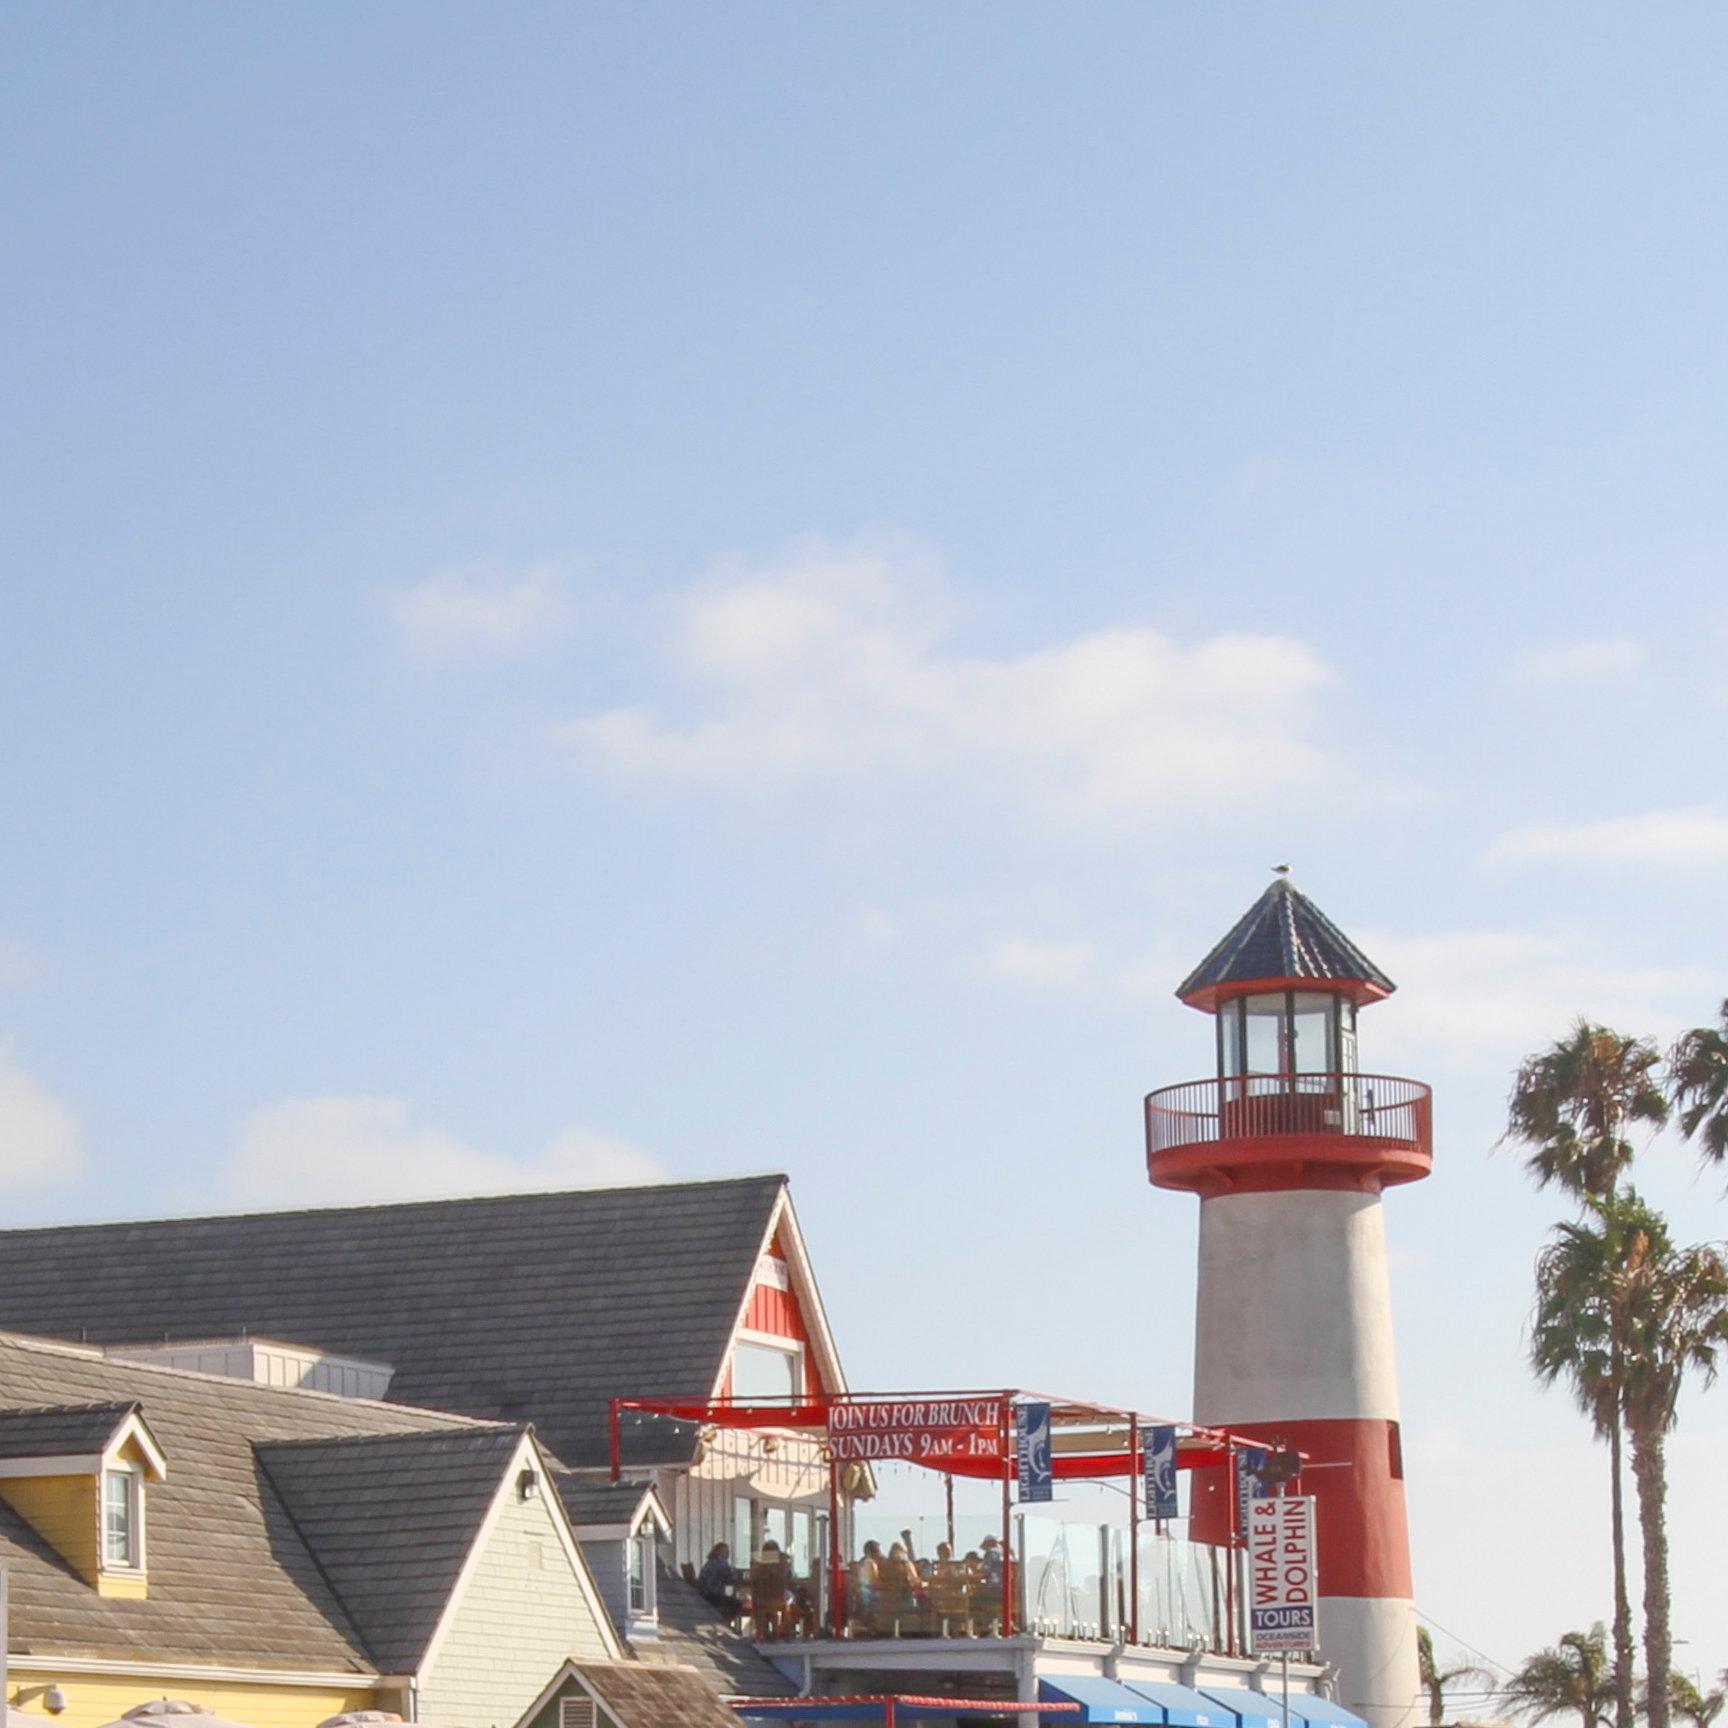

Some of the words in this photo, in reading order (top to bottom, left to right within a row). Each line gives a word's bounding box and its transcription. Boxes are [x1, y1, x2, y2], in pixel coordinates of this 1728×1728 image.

[828, 1406, 867, 1431] JOIN
[869, 1405, 889, 1428] US
[891, 1404, 925, 1427] FOR
[928, 1402, 1000, 1426] BRUNCH
[829, 1433, 914, 1459] SUNDAYS
[920, 1433, 953, 1457] 9AM
[968, 1433, 999, 1455] 1PM
[1018, 1405, 1030, 1501] LIGHTHOUSE
[1254, 1501, 1276, 1516] &
[1254, 1524, 1278, 1604] WHALE
[1283, 1500, 1308, 1604] DOLPHIN
[1255, 1610, 1311, 1627] TOURS
[1255, 1631, 1311, 1641] OCEANSIDE
[1255, 1640, 1311, 1649] ADVENTURES
